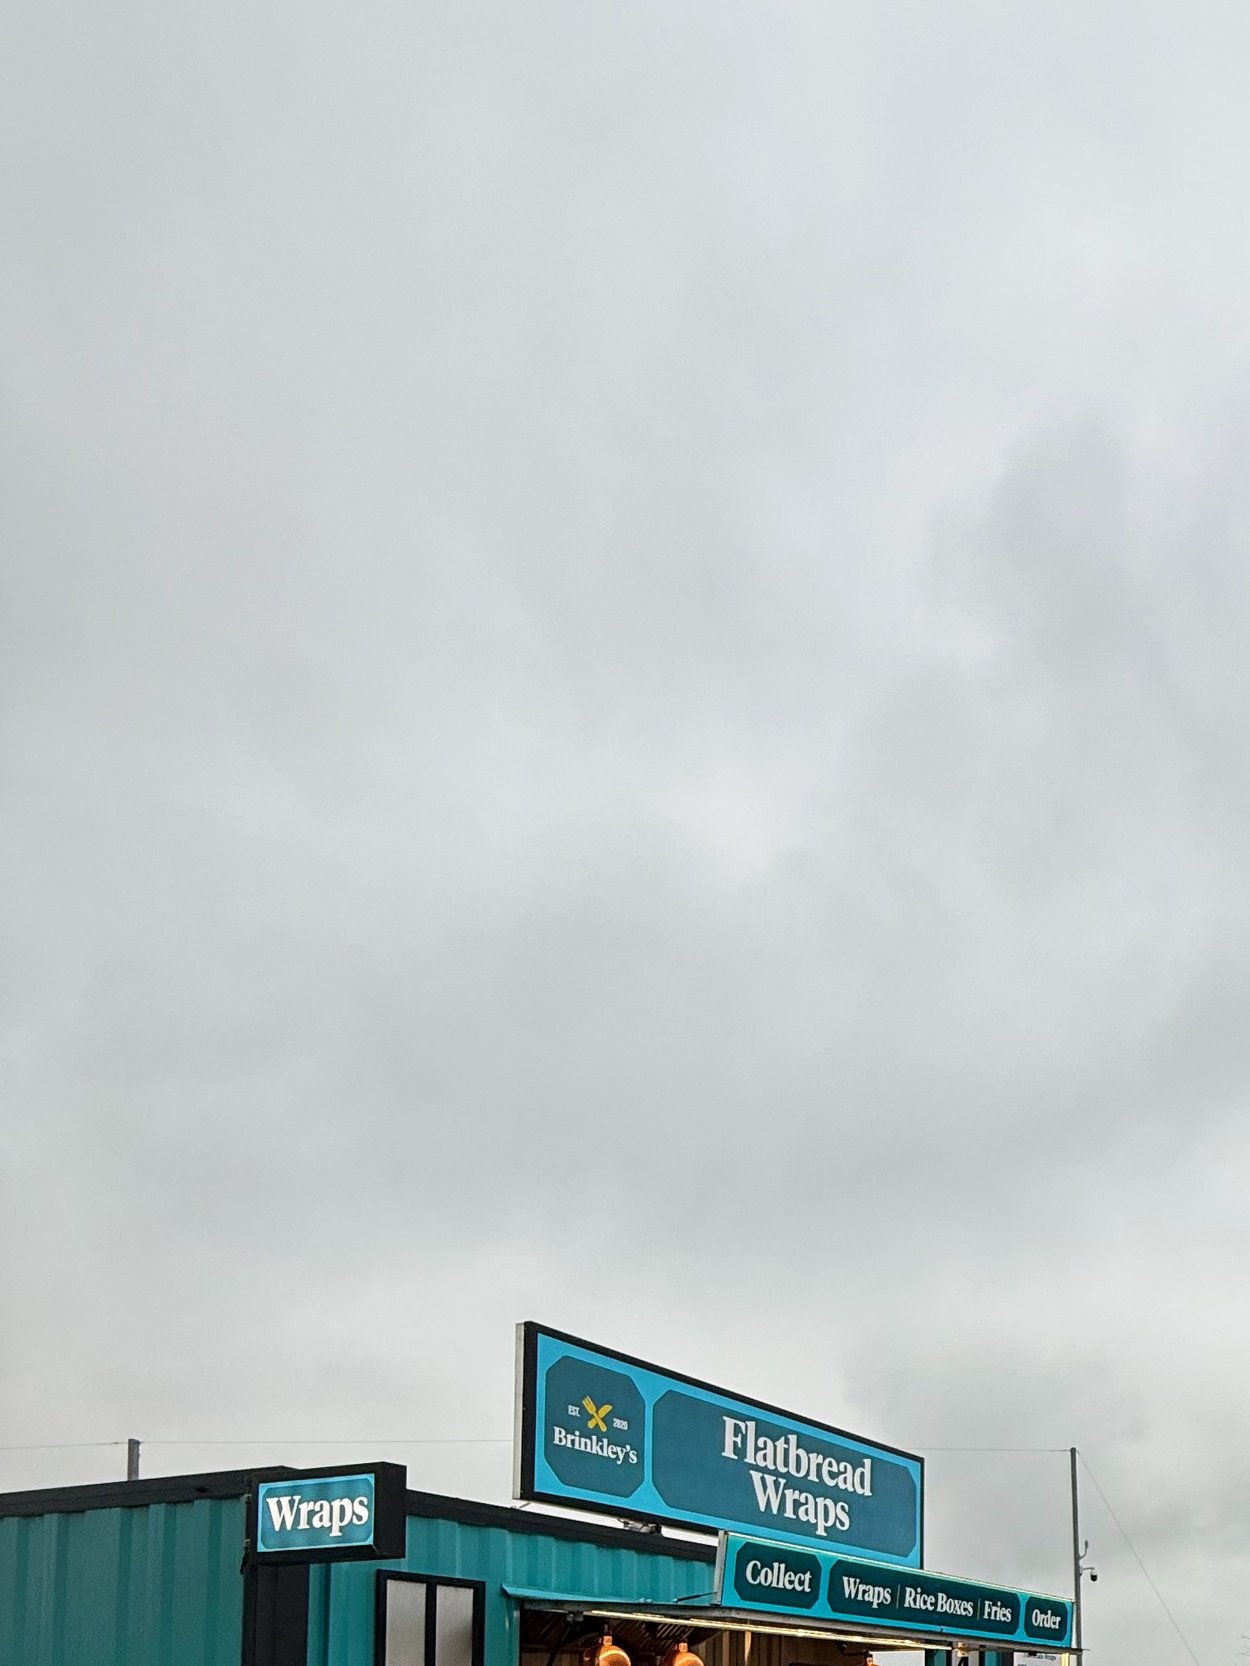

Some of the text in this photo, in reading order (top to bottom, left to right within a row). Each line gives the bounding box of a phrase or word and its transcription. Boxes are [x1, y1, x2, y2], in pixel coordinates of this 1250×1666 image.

[552, 1425, 638, 1465] Brinkley's
[721, 1415, 873, 1496] Flatbread
[265, 1495, 370, 1538] Wraps
[749, 1469, 851, 1537] Wraps
[745, 1559, 813, 1593] Collect
[842, 1575, 1013, 1623] Wraps Rice Boxes Fries
[1031, 1608, 1062, 1630] Order
